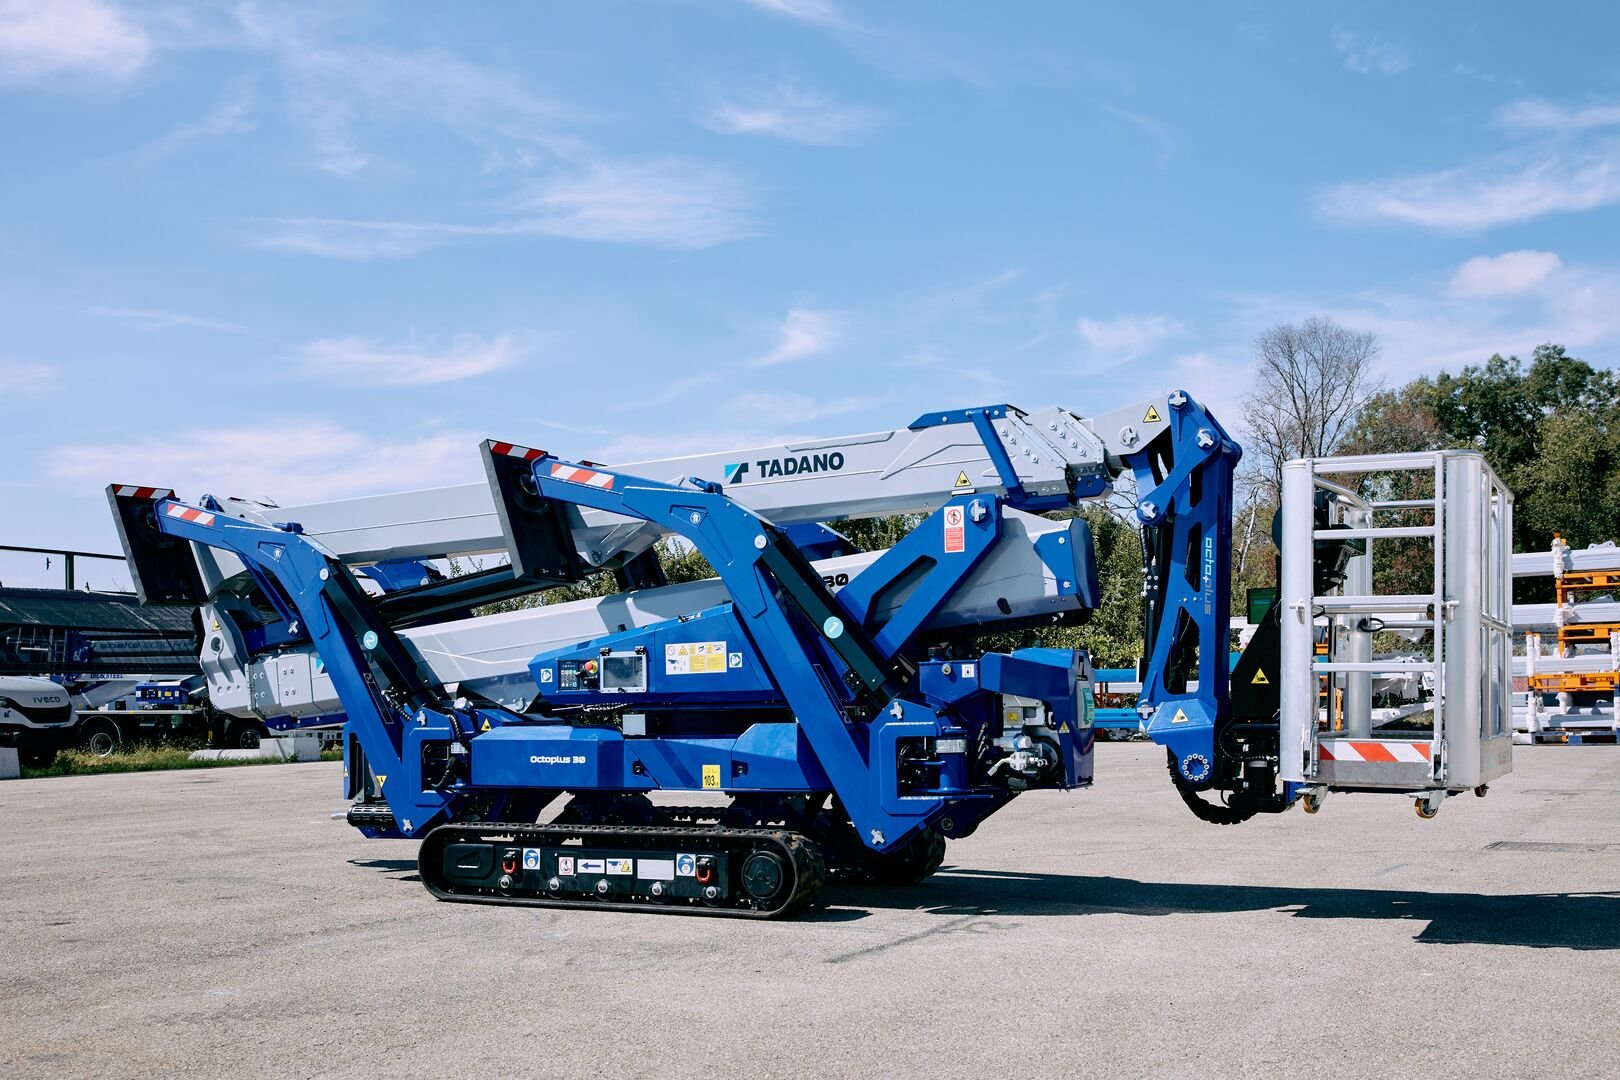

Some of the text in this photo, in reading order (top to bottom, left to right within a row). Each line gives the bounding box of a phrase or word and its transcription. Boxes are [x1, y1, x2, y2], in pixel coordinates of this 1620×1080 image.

[757, 452, 844, 478] TADANO
[1203, 537, 1214, 616] octoplus
[530, 756, 586, 765] Octoplus 30
